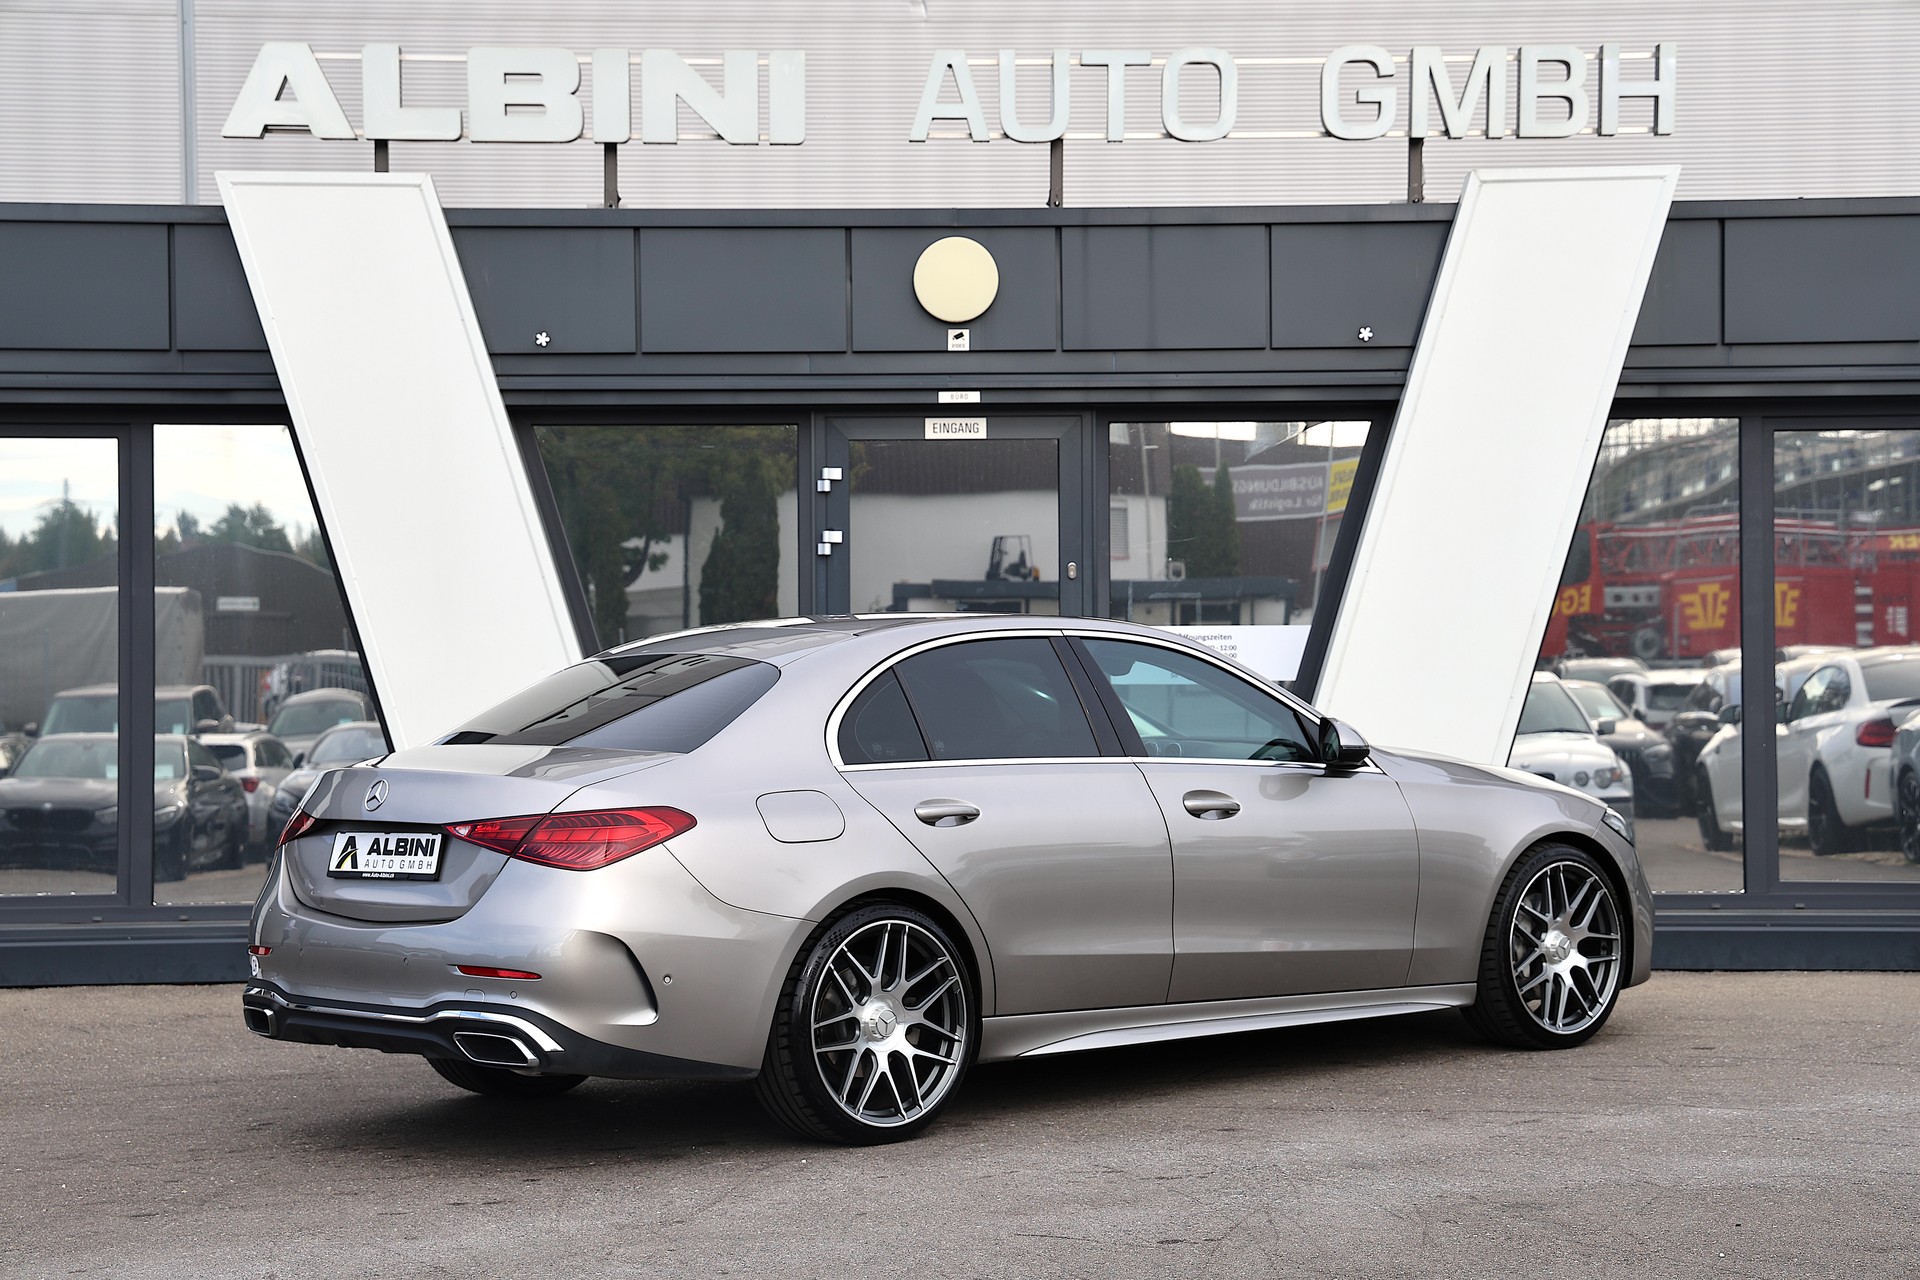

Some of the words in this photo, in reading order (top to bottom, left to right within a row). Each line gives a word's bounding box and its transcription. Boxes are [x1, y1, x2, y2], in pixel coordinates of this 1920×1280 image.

[221, 42, 806, 145] ALBINI
[908, 46, 1238, 142] AUTO
[1319, 43, 1678, 140] GMBH
[932, 422, 980, 434] EINGANG
[366, 837, 436, 857] ALBINI
[364, 859, 394, 869] AUTO
[399, 859, 433, 870] GMBH
